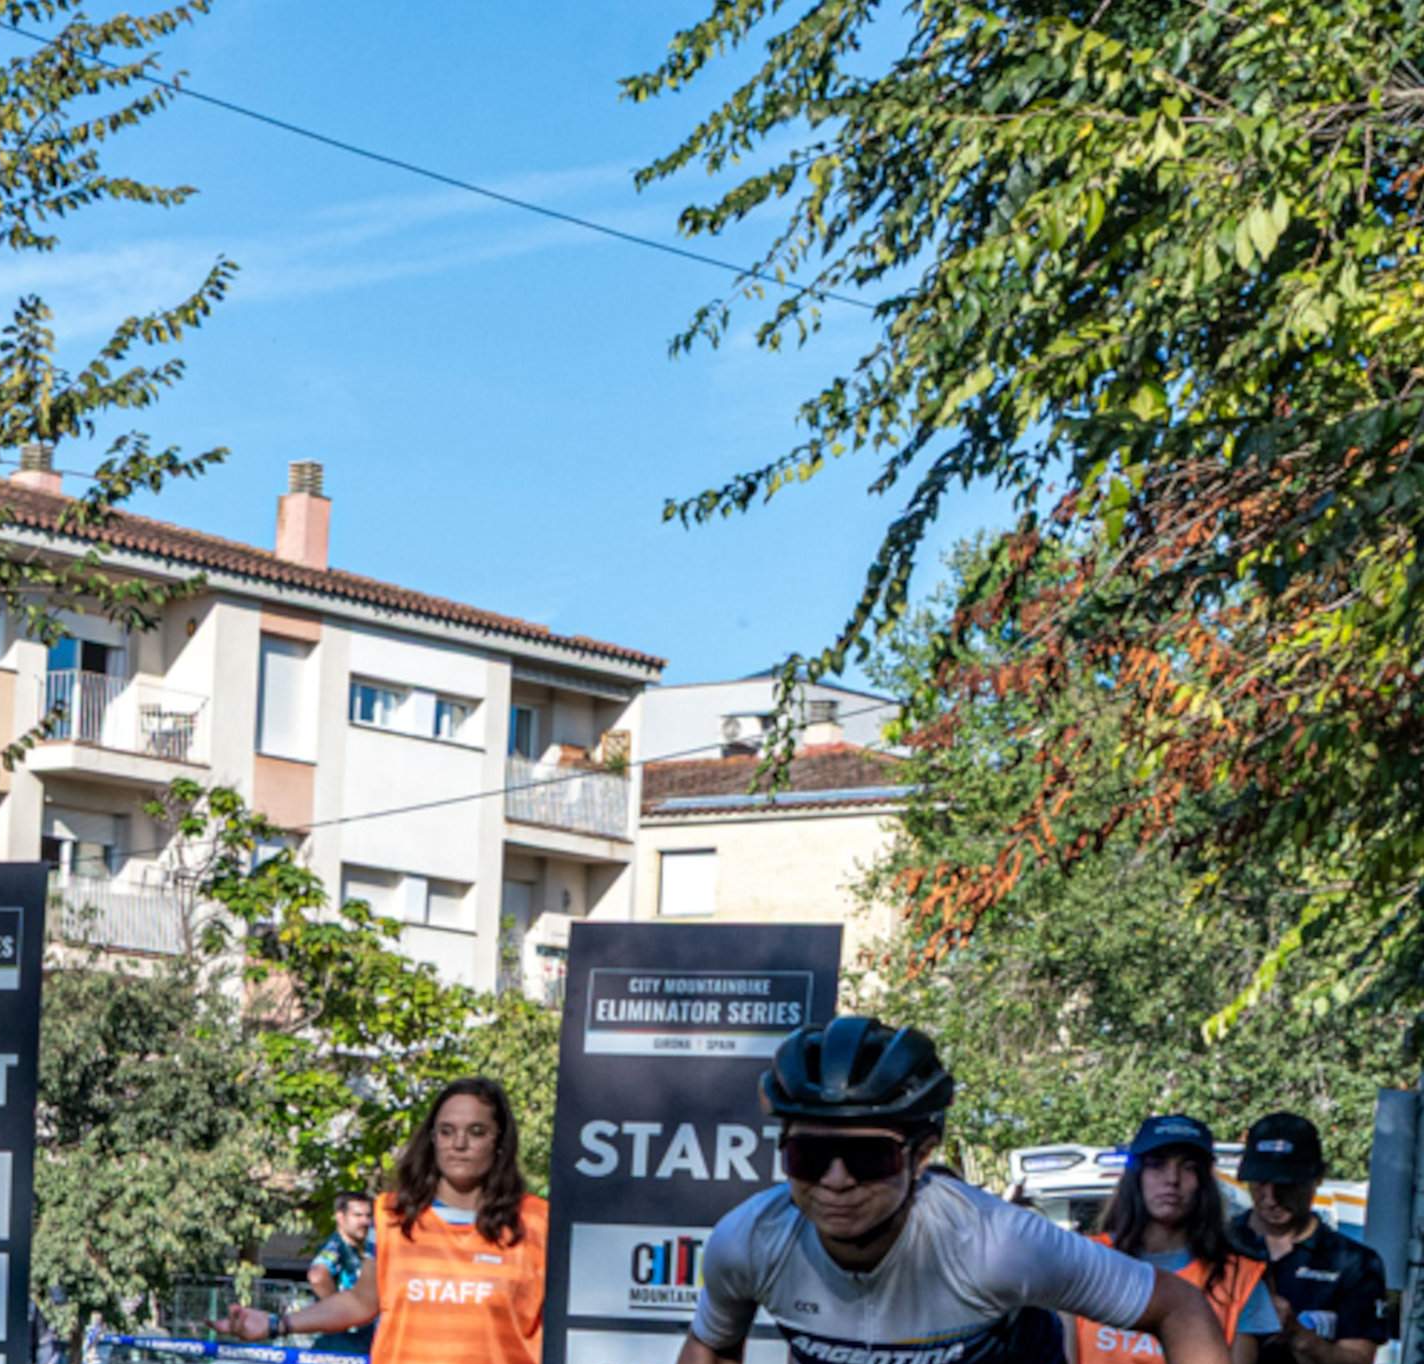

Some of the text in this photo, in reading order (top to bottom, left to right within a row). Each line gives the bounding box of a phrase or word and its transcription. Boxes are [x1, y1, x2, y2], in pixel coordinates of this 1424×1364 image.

[629, 978, 771, 996] CITY MOUNTAINBIKE
[596, 999, 801, 1025] ELIMINATOR SERIES
[574, 1120, 789, 1182] START
[631, 1236, 705, 1286] CIT
[407, 1278, 495, 1304] STAFF
[629, 1288, 700, 1302] MOUNTAIN
